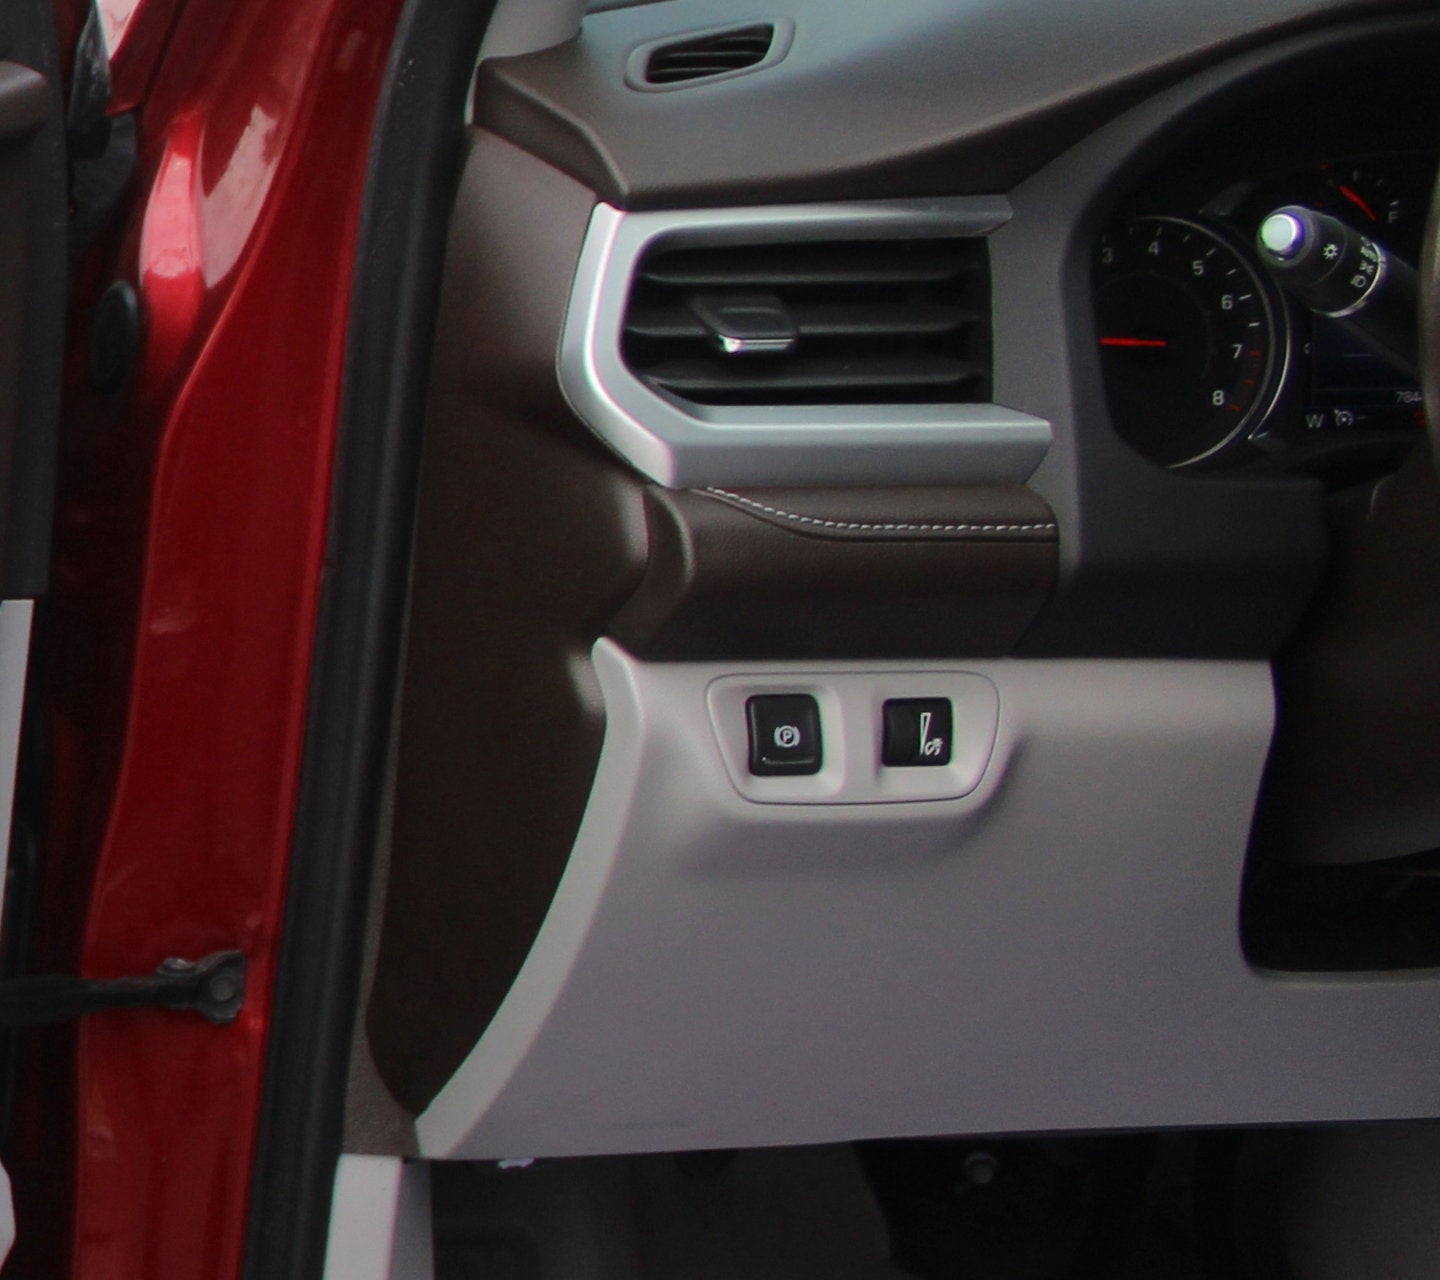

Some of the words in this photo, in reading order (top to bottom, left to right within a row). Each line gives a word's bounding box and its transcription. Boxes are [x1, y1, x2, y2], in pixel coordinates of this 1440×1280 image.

[1101, 246, 1113, 264] 3
[1147, 240, 1160, 256] 4
[1191, 259, 1204, 276] 5
[1220, 294, 1233, 310] 6
[1231, 343, 1243, 360] 7
[1211, 389, 1225, 406] 8
[1305, 413, 1325, 429] W
